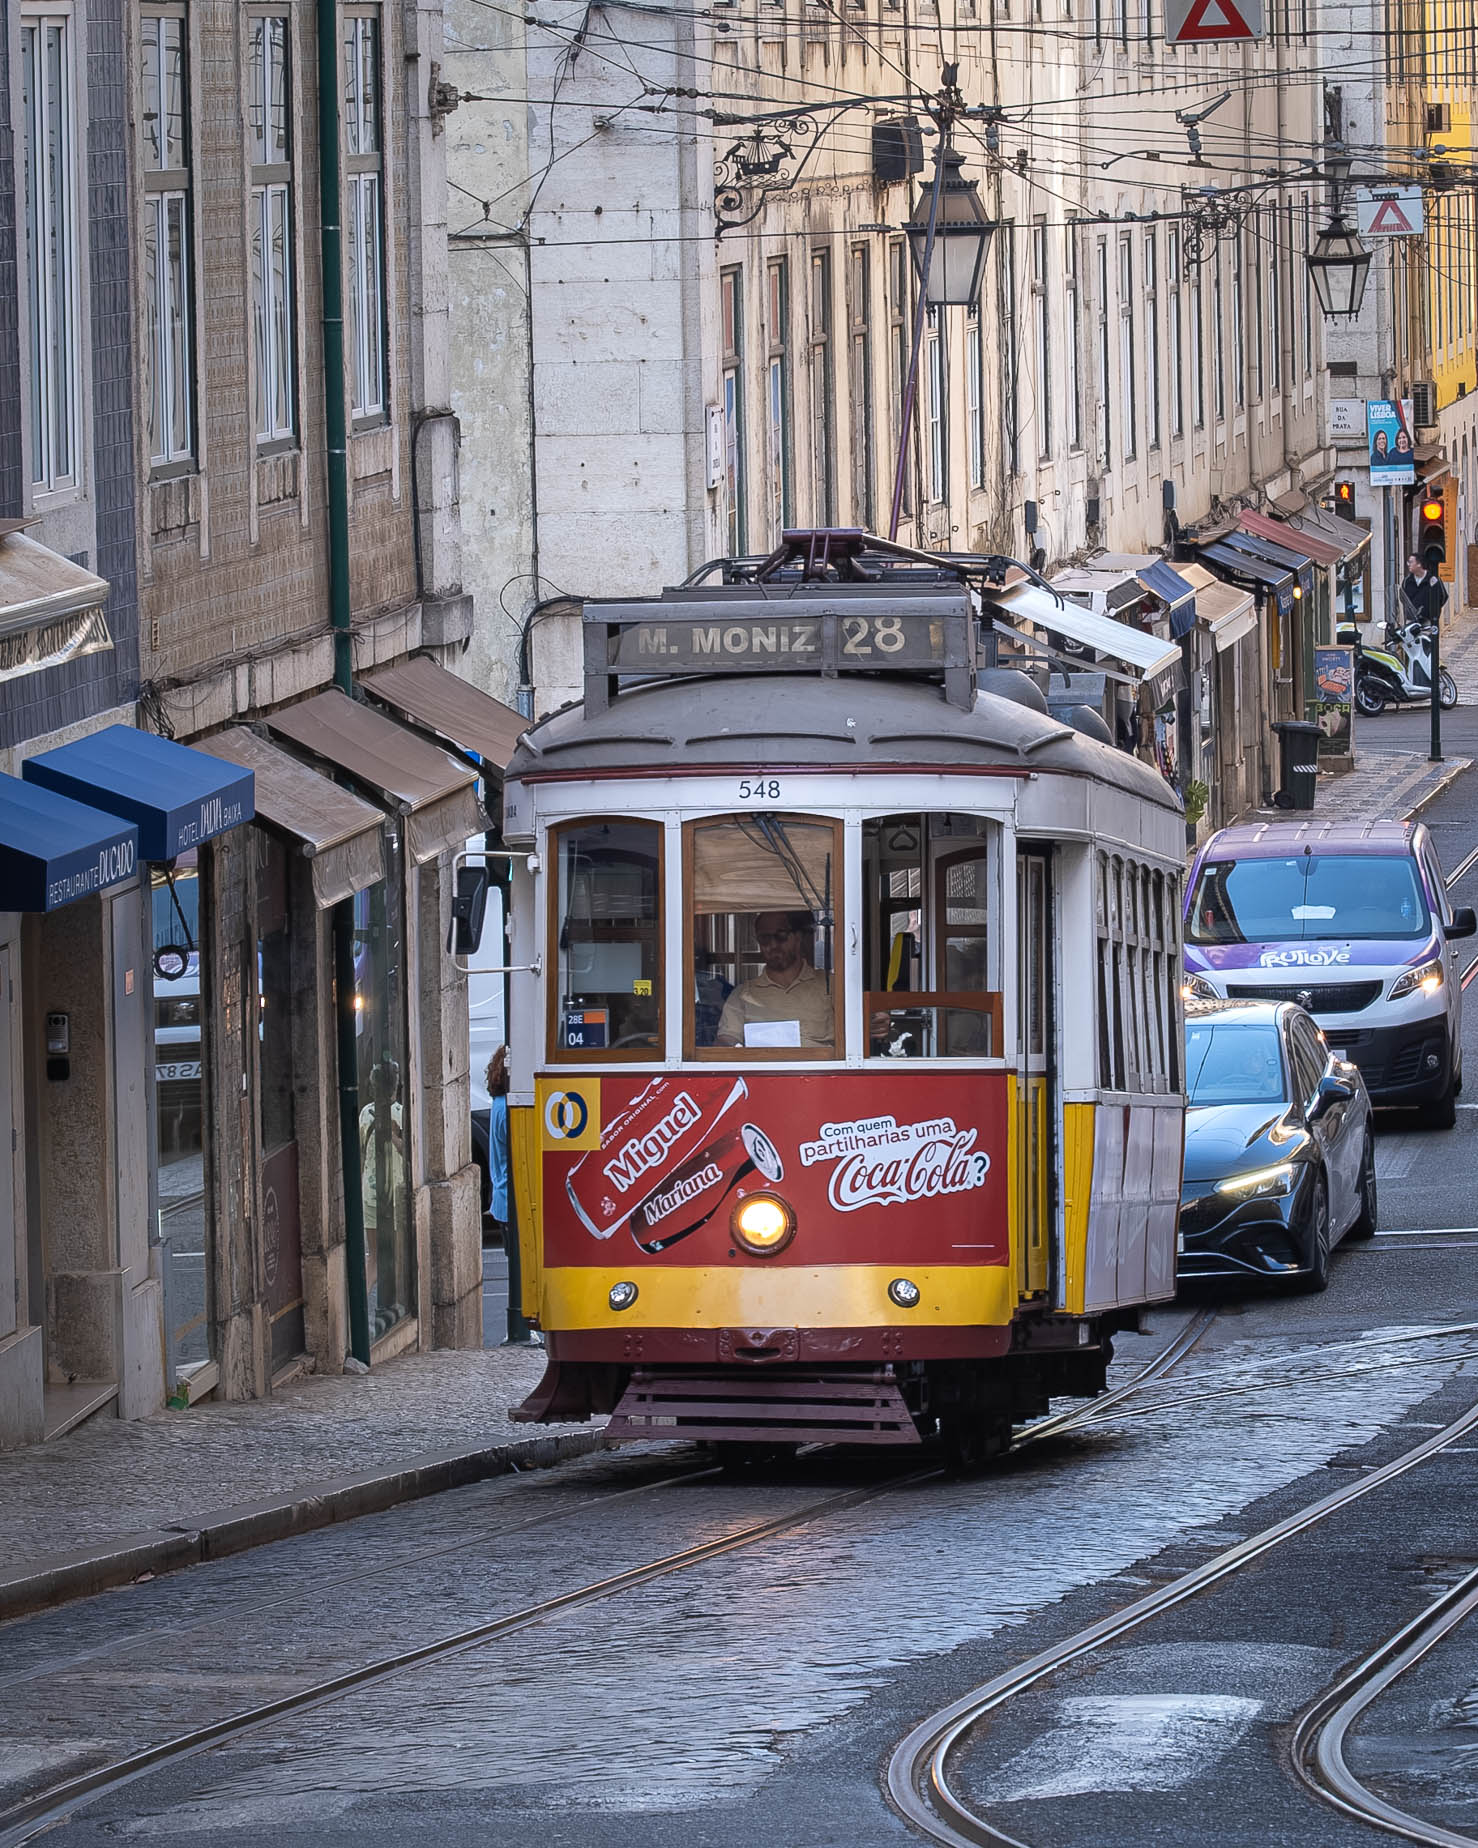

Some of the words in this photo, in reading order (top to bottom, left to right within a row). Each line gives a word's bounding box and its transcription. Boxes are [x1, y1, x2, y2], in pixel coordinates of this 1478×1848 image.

[1370, 411, 1396, 419] LISBOA
[638, 627, 679, 654] M.
[691, 625, 816, 654] MONIZ
[842, 616, 906, 655] 28
[1316, 704, 1350, 713] BOCA
[739, 780, 781, 799] 548
[178, 821, 199, 848] HOTEL
[223, 801, 242, 827] BAIXA
[49, 866, 99, 905] RESTAURANTE
[99, 839, 134, 885] DUCADO
[568, 1015, 583, 1025] 28E
[568, 1032, 584, 1046] 04
[601, 1125, 623, 1150] SABOR
[624, 1096, 656, 1126] ORIGINAL
[603, 1092, 702, 1192] Miguel
[804, 1129, 910, 1161] partilharias
[915, 1121, 953, 1138] uma
[824, 1126, 853, 1137] Com
[857, 1118, 892, 1133] quem
[643, 1163, 723, 1225] Mariana
